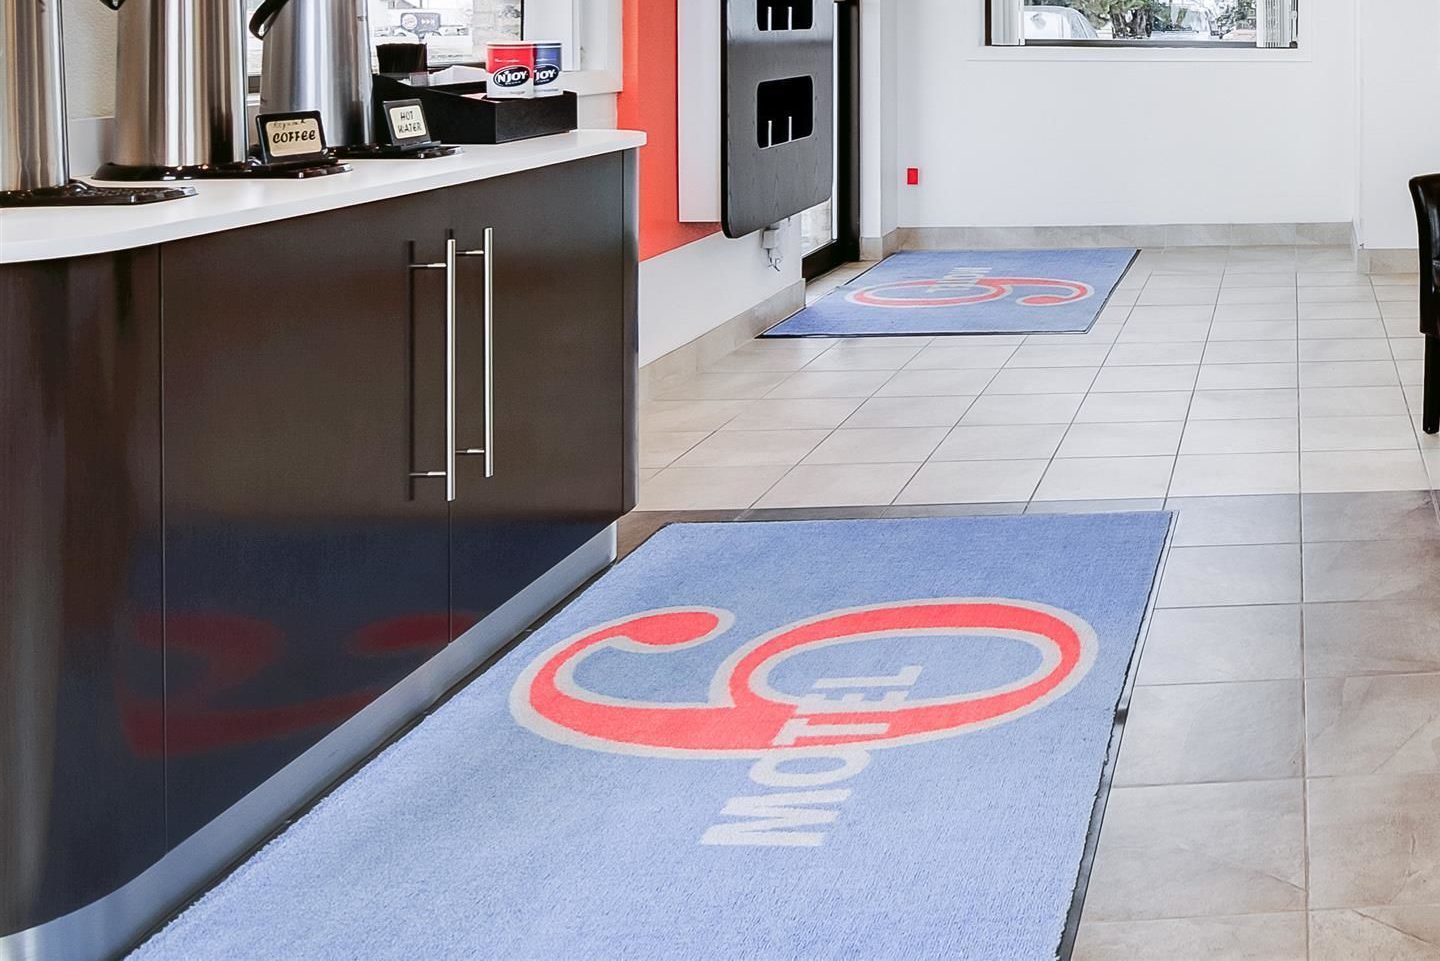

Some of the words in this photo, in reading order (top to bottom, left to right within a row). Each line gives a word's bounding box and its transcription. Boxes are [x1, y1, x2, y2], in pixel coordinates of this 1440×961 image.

[400, 110, 414, 121] HOT
[397, 121, 422, 133] WATER
[272, 129, 317, 144] COFFEE
[509, 597, 1099, 760] 6
[699, 665, 924, 847] MOTEL
